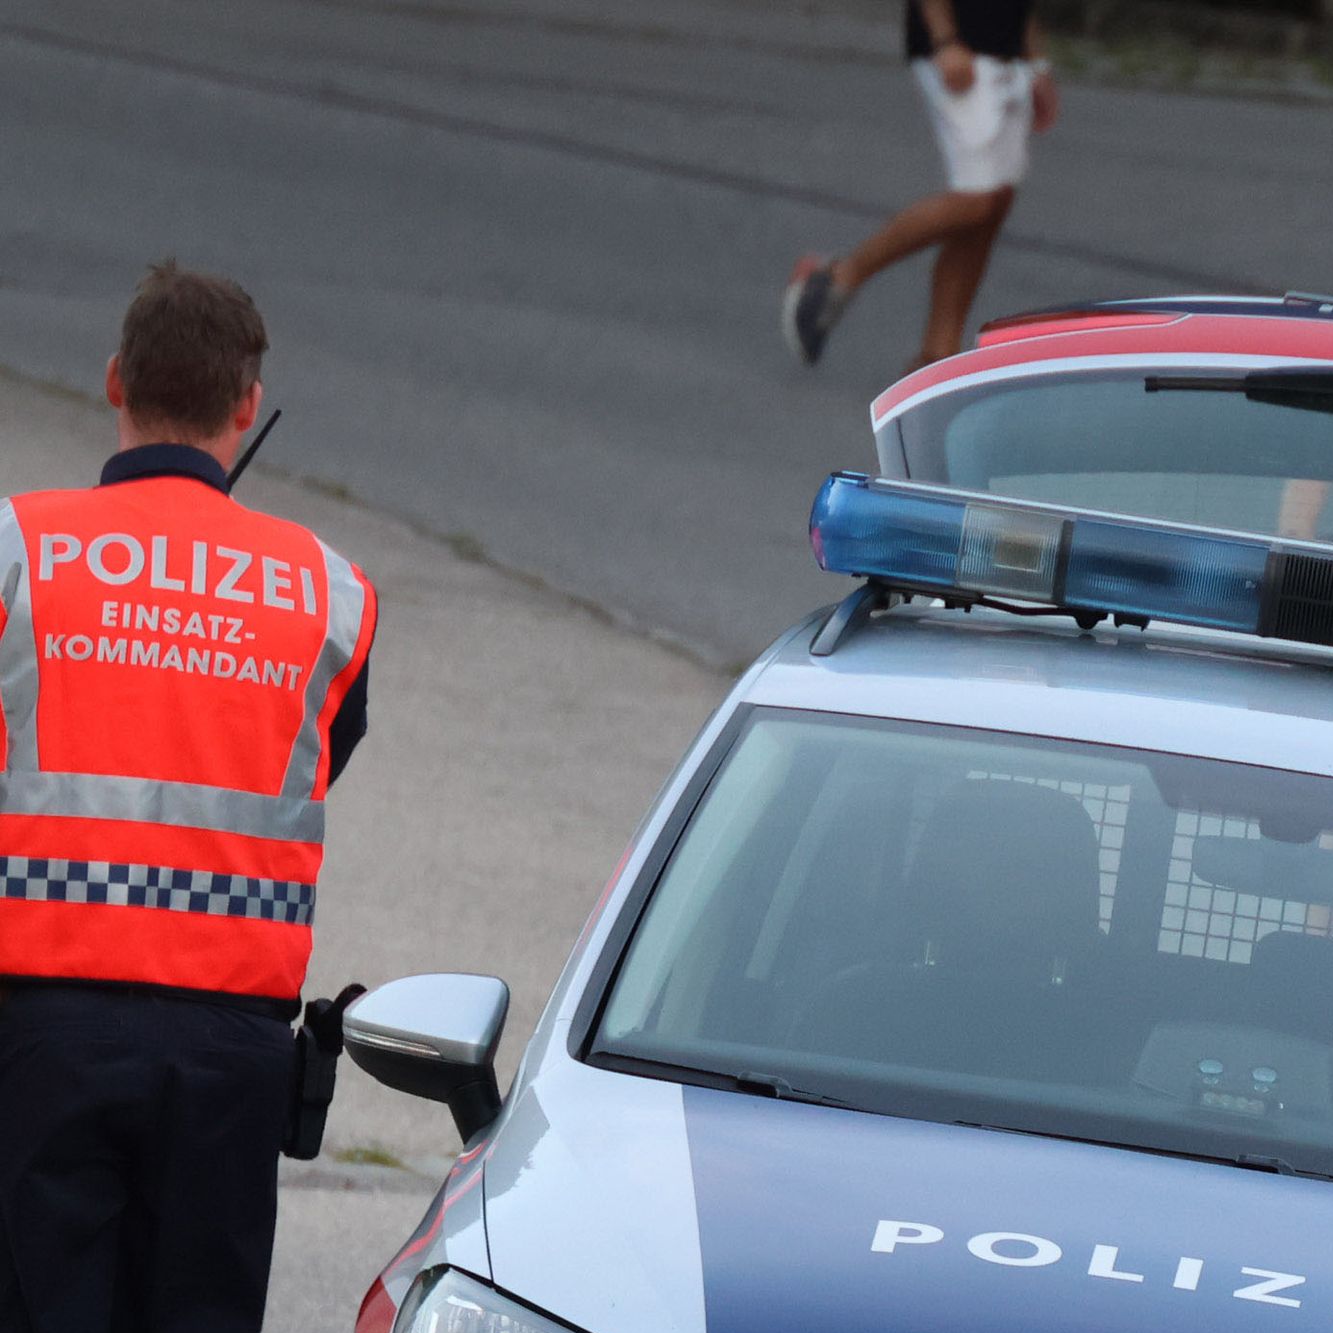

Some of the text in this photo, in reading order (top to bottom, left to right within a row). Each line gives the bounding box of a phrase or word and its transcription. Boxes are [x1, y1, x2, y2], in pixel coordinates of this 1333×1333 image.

[38, 532, 317, 616] POLIZEI
[101, 600, 256, 645] EINSATZ-
[44, 633, 303, 692] KOMMANDANT
